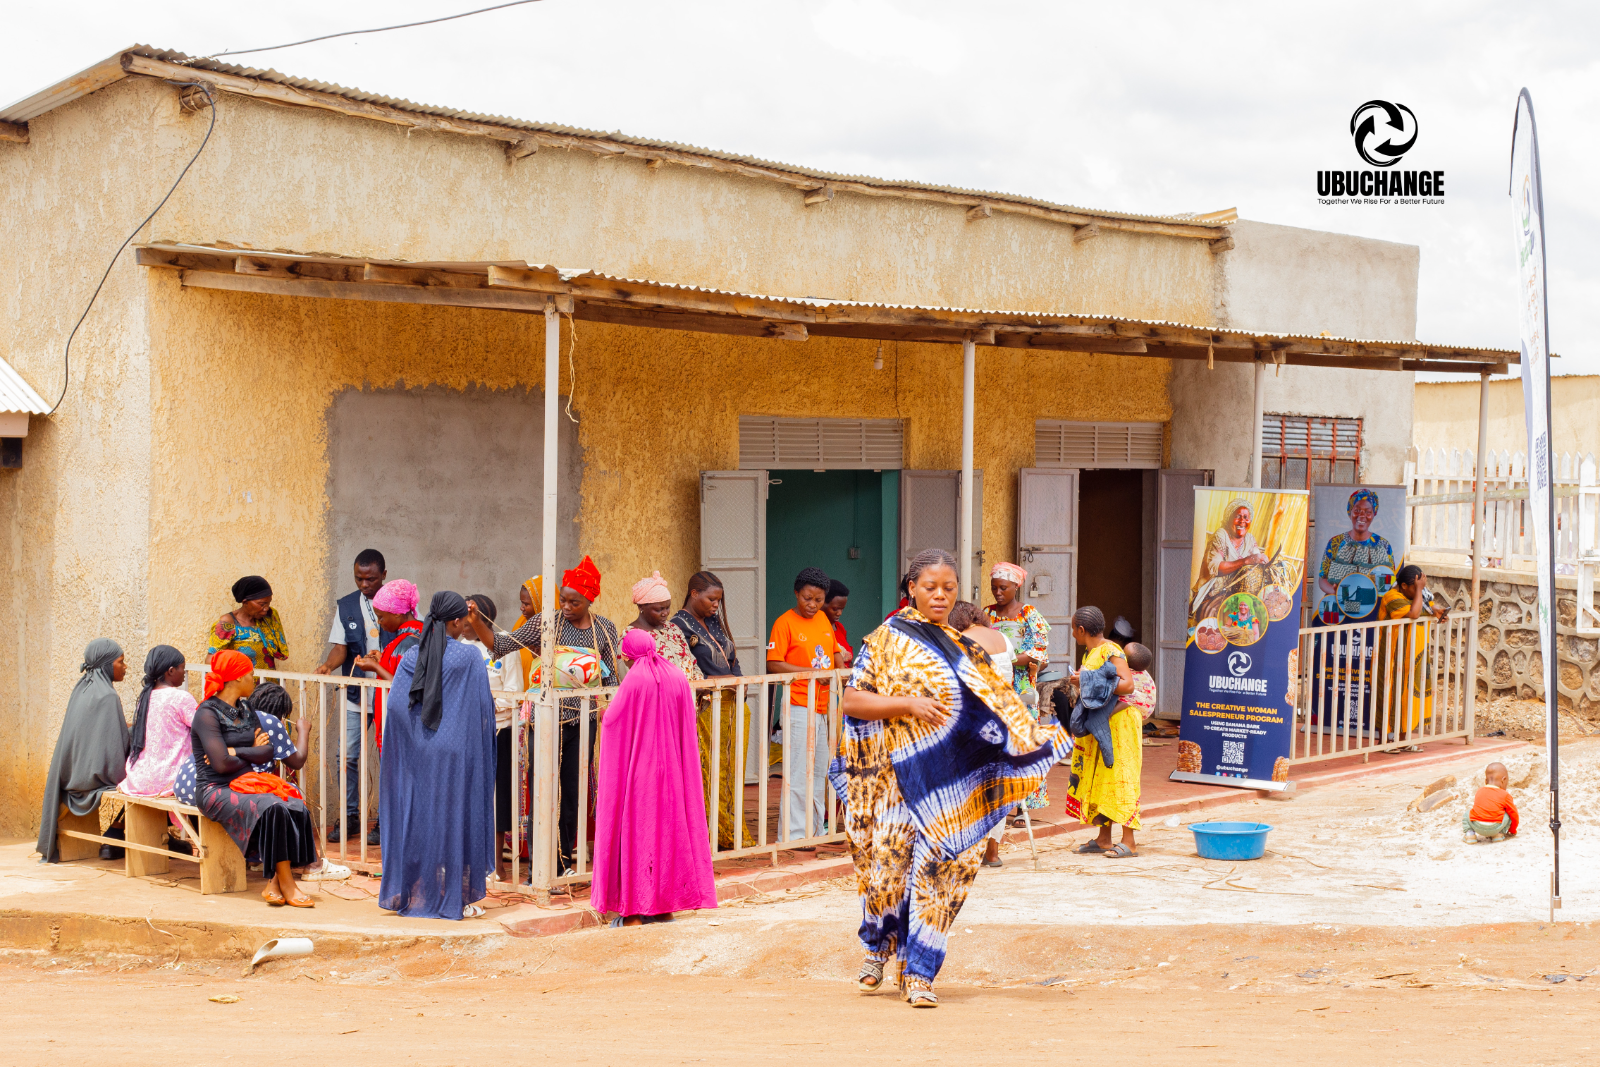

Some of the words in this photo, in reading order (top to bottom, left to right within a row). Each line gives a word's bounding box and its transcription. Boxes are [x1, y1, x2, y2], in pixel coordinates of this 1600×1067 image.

[1209, 675, 1268, 693] UBUCHANGE
[1196, 701, 1210, 709] THE
[1211, 703, 1246, 712] CREATIVE
[1247, 706, 1278, 715] WOMAN
[1189, 709, 1245, 720] SALESPRENEUR
[1246, 714, 1284, 724] PROGRAM
[1216, 765, 1249, 773] @ubuchange
